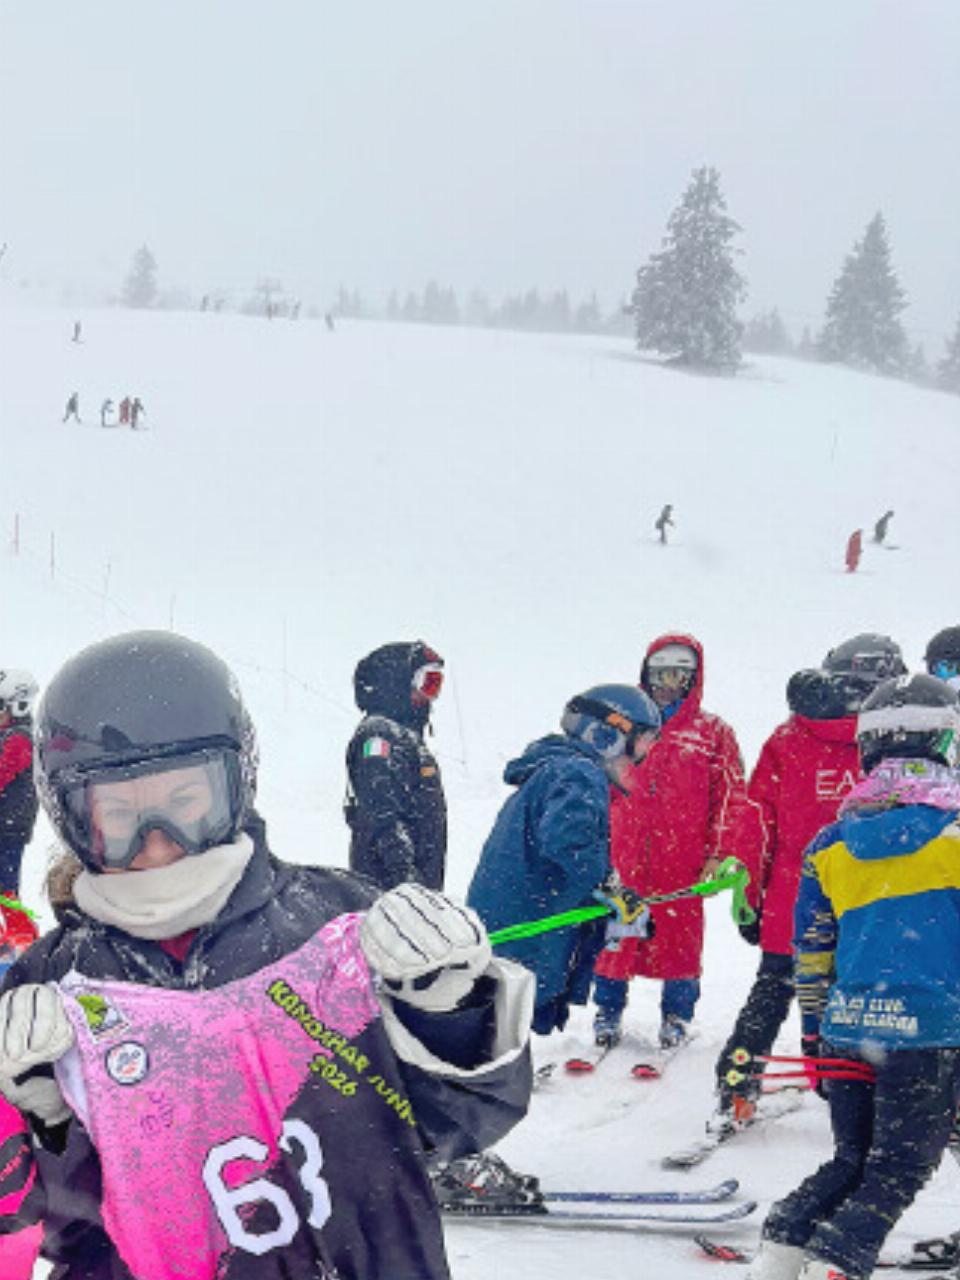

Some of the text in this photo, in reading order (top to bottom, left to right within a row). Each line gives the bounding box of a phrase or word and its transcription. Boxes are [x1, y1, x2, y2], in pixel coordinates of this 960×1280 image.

[815, 769, 866, 794] EA
[267, 980, 416, 1127] KANDAHAR JUNI
[309, 1054, 358, 1097] 2026
[202, 1119, 332, 1256] 63
